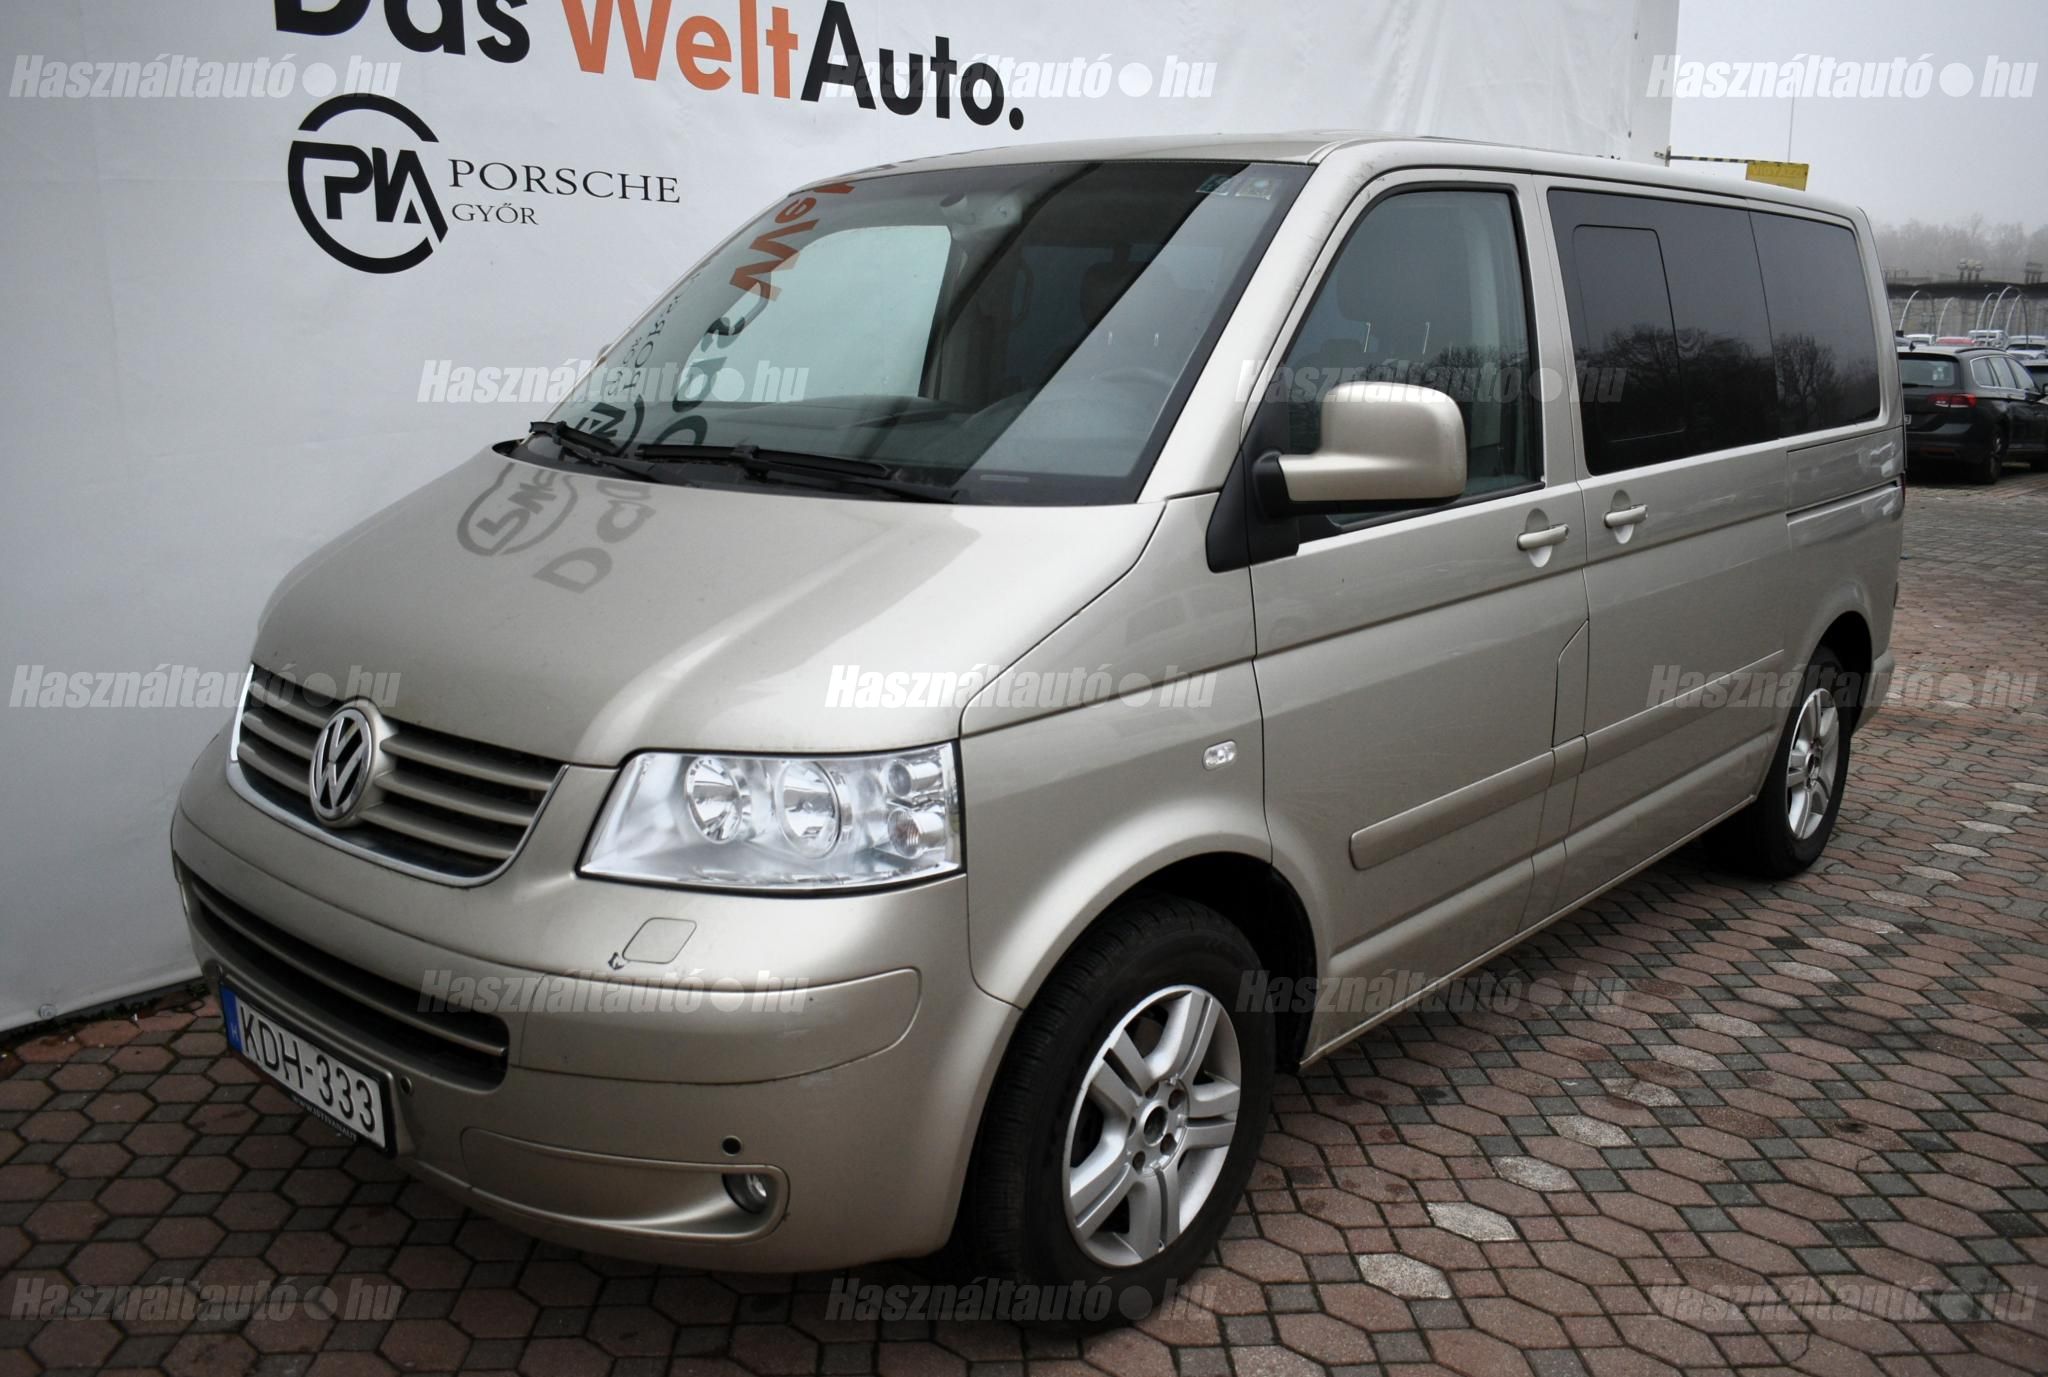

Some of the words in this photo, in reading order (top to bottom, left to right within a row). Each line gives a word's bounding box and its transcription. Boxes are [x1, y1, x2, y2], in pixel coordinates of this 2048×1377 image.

[448, 159, 681, 204] PORSCHE
[451, 202, 539, 225] GYŐR
[240, 1005, 376, 1133] KDH-333
